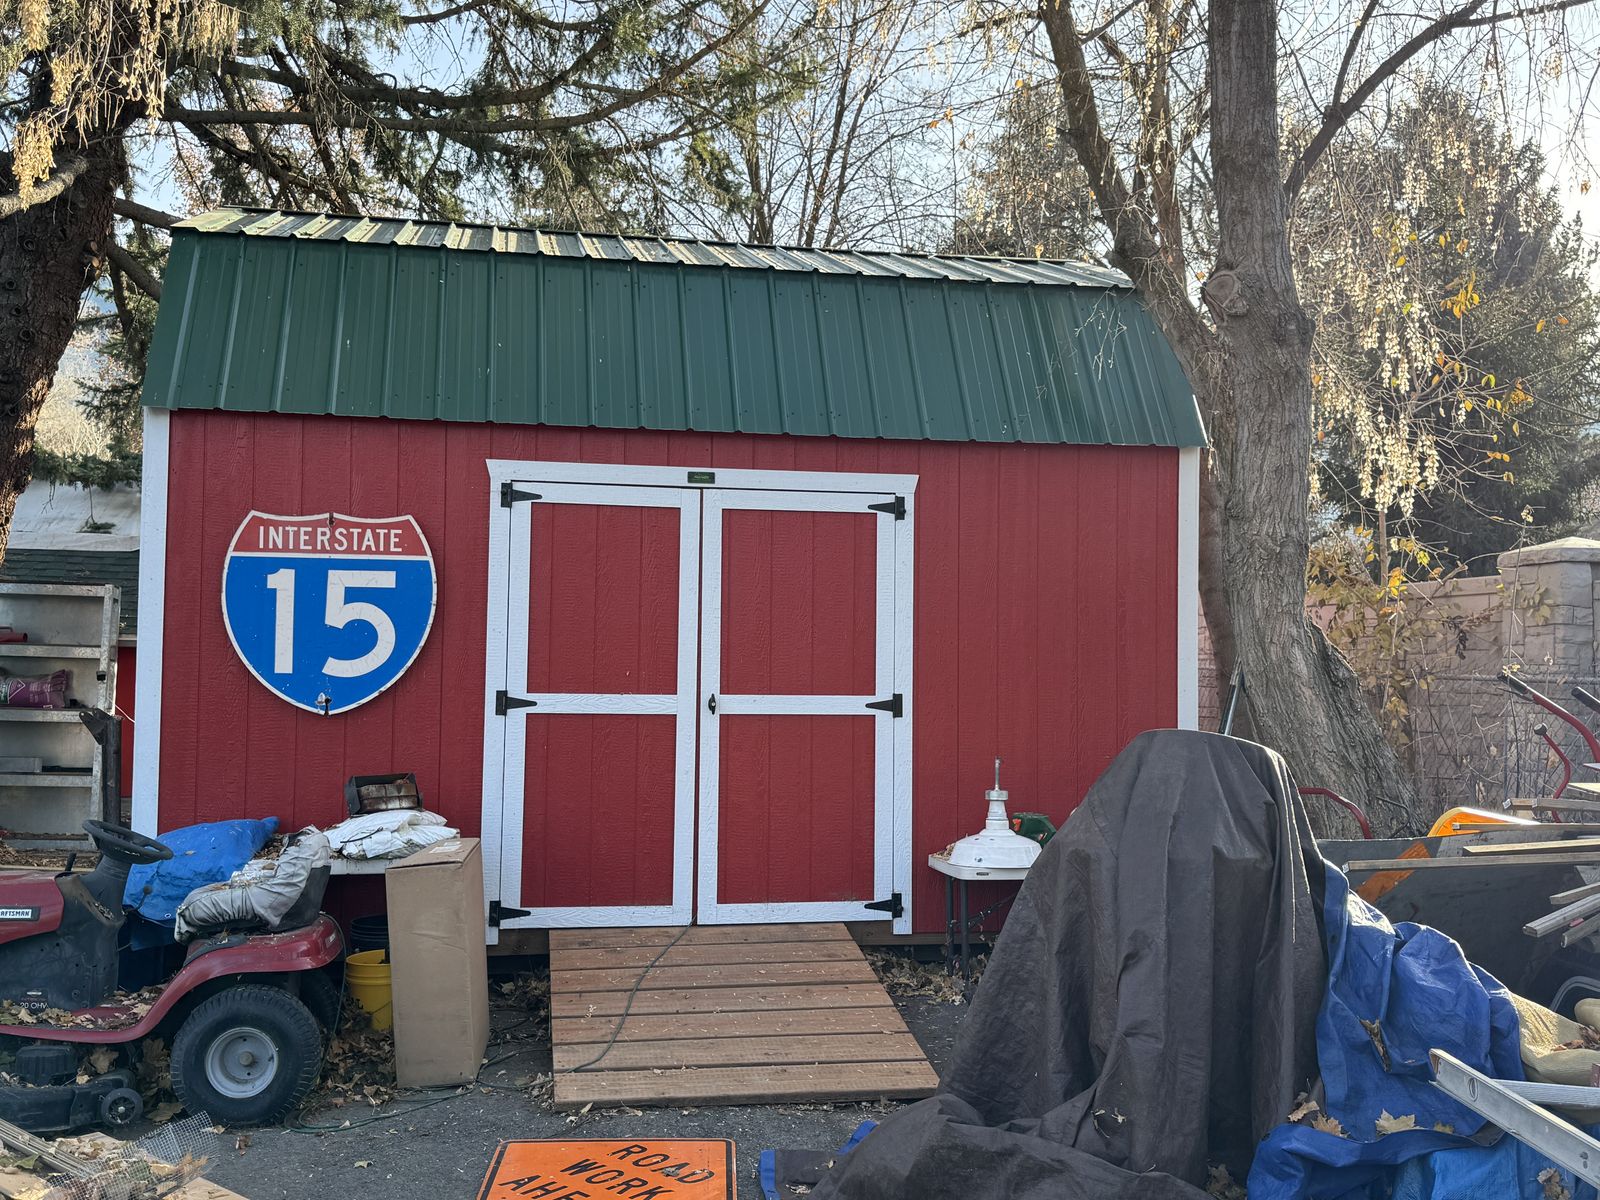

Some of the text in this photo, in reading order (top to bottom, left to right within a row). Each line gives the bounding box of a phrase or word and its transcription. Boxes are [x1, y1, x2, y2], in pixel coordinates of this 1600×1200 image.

[258, 525, 403, 552] INTERSTATE
[266, 568, 397, 678] 15
[560, 1158, 675, 1200] WORK
[607, 1144, 715, 1184] ROAD
